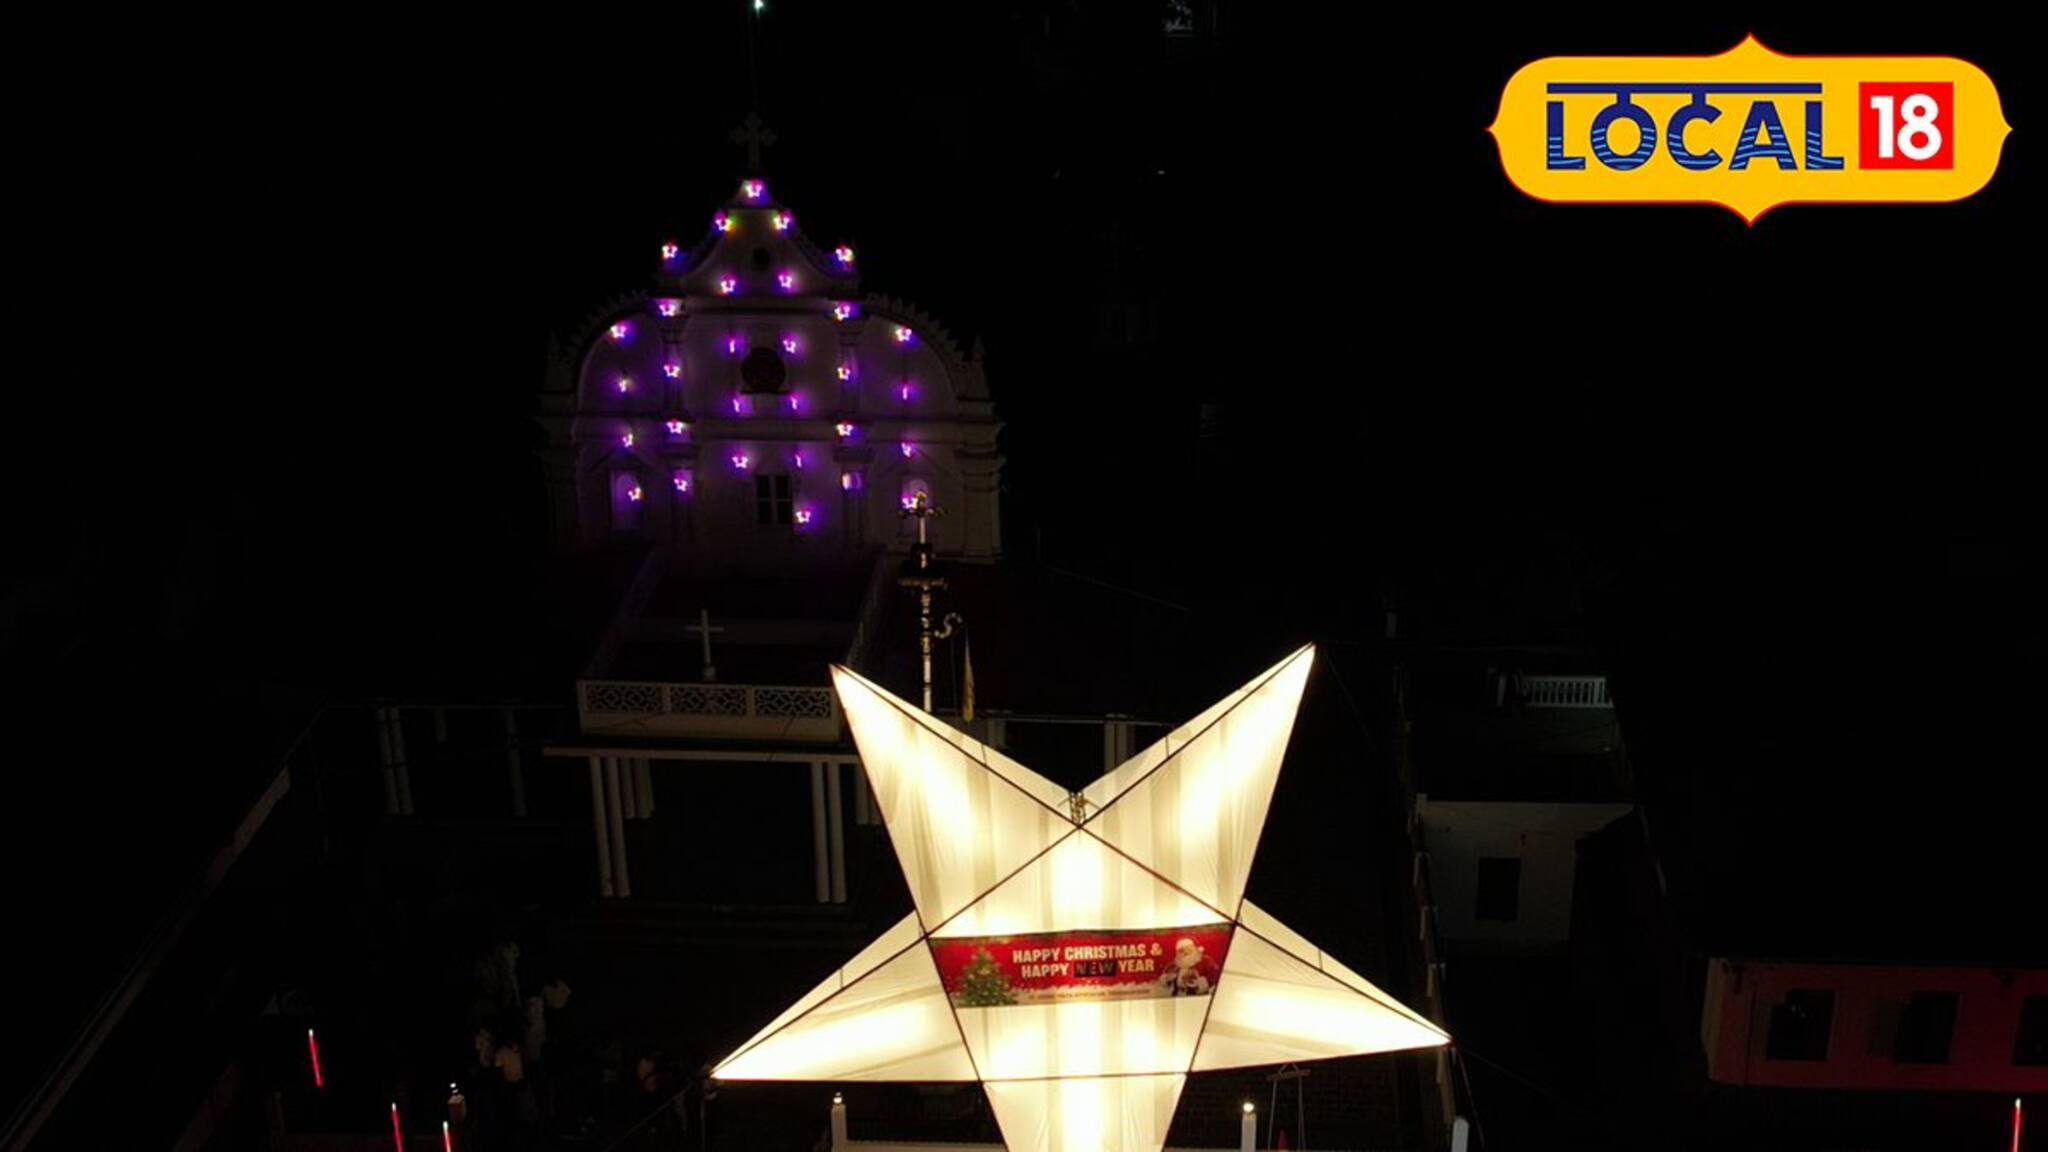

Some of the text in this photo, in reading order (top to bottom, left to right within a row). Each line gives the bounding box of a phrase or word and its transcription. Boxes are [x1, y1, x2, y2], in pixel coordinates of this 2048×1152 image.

[1012, 943, 1162, 963] HAPPY CHRISTMAS &
[1021, 959, 1154, 978] HAPPY NEW YEAR
